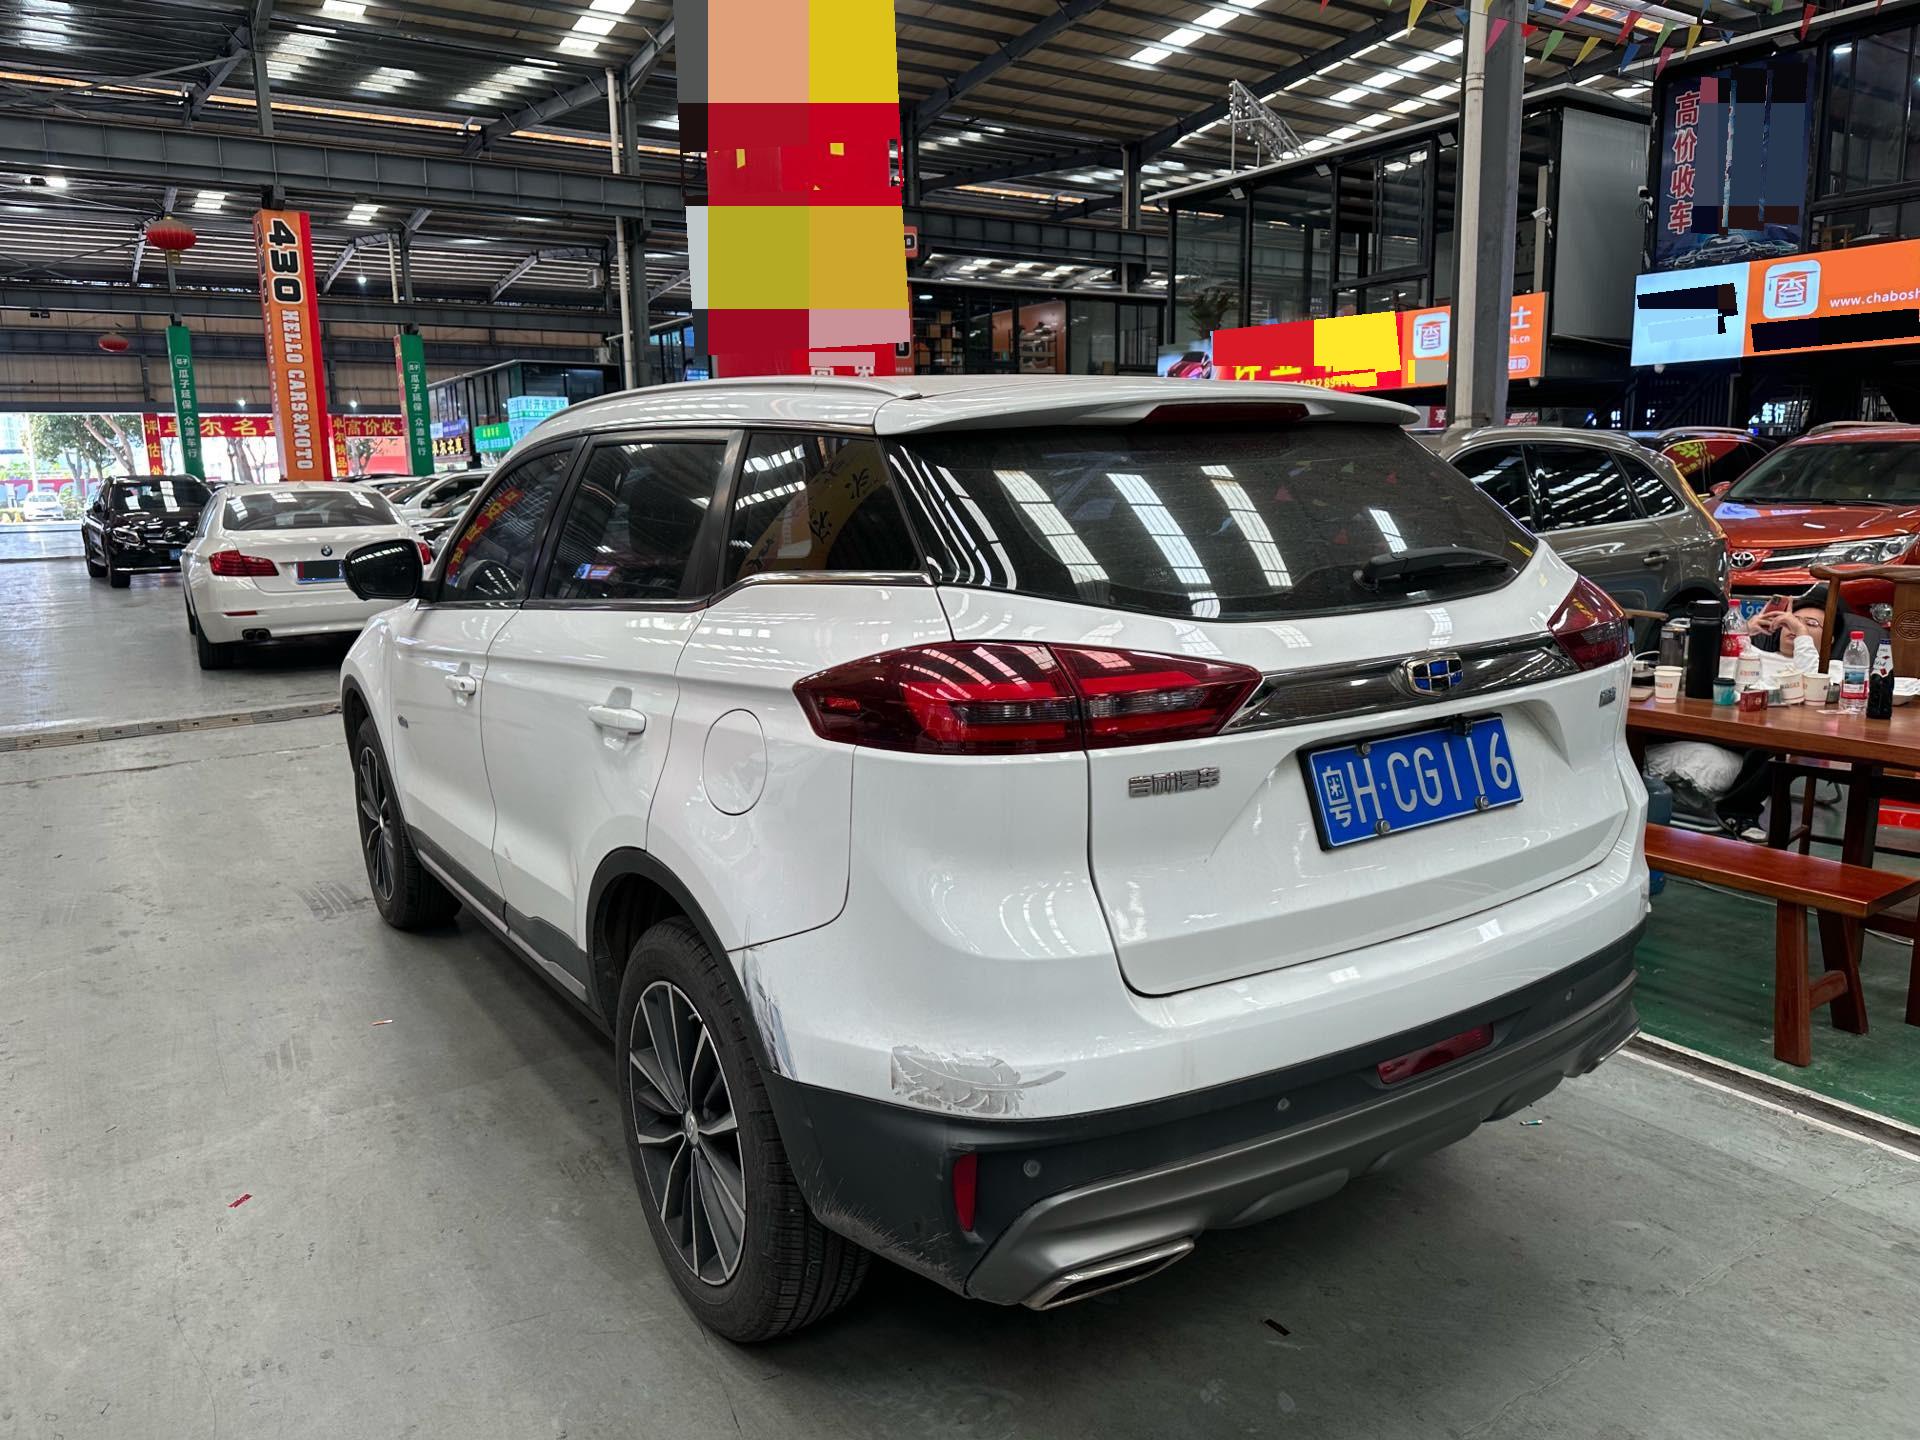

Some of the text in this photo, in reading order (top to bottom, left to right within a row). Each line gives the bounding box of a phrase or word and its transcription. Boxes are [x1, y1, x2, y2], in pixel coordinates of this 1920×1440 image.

[1668, 90, 1700, 235] 高价收车
[267, 217, 304, 304] 430
[281, 309, 314, 470] HELLO CARS&MOTO
[345, 419, 403, 436] 高价收
